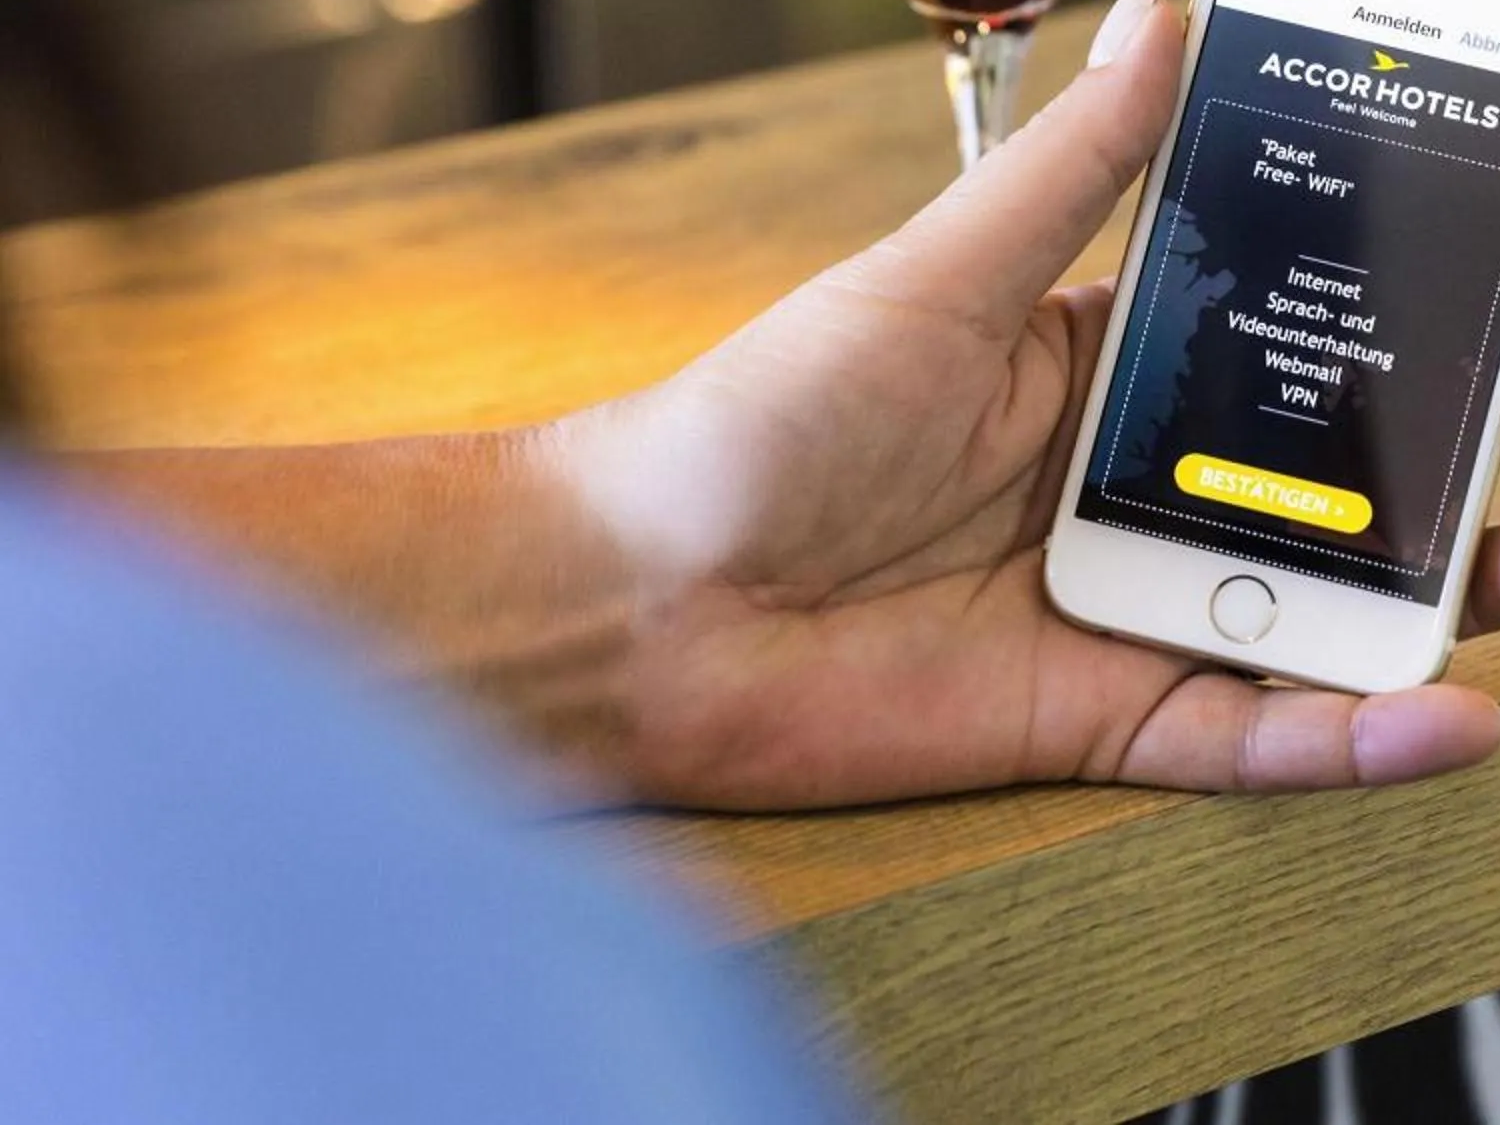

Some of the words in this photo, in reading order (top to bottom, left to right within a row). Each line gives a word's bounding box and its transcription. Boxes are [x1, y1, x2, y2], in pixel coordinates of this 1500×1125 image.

[1352, 5, 1443, 40] Anmelden
[1330, 98, 1356, 114] Feel
[1360, 105, 1417, 128] Welcome
[1287, 267, 1362, 301] Internet
[1266, 291, 1335, 323] Sprach-
[1340, 312, 1376, 333] und
[1228, 310, 1395, 371] Videounterhaltung
[1265, 349, 1343, 385] Webmail
[1281, 383, 1318, 408] VPN
[1200, 466, 1330, 515] BESTÄTIGEN
